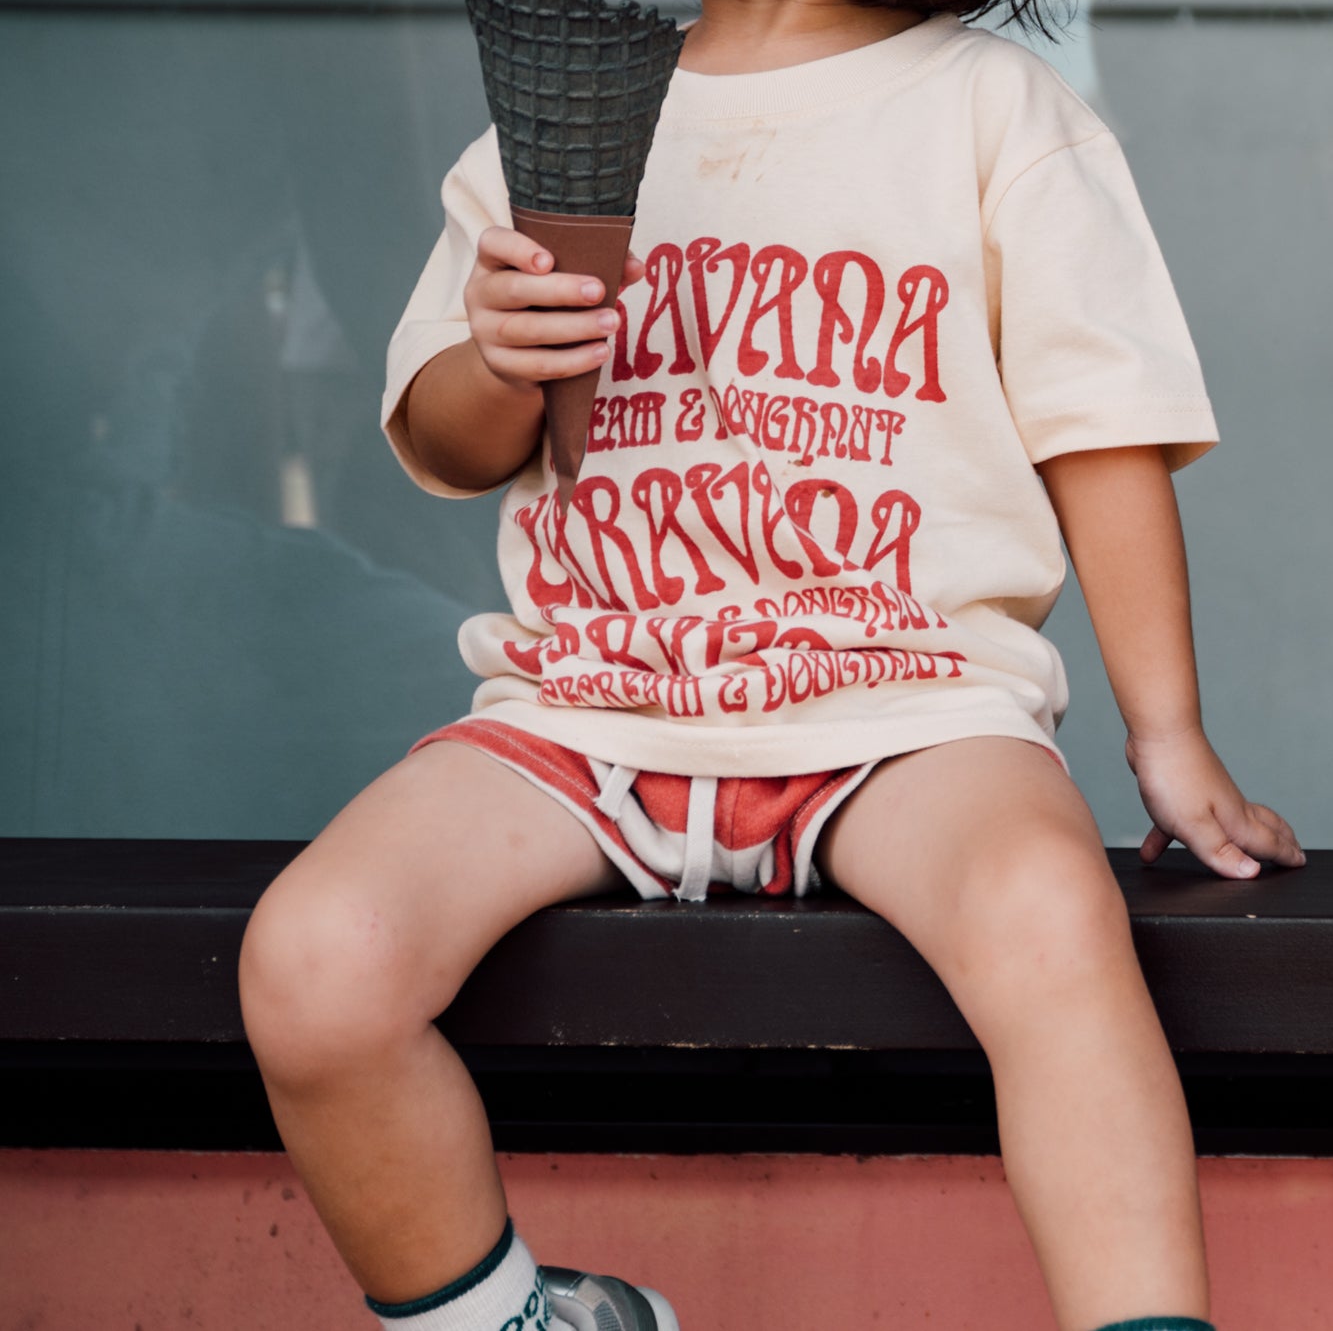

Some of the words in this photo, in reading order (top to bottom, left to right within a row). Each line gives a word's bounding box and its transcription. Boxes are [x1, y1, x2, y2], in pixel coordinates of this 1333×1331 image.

[611, 236, 949, 403] AVANA
[586, 390, 667, 454] EAM
[674, 387, 706, 443] &
[717, 674, 748, 714] &
